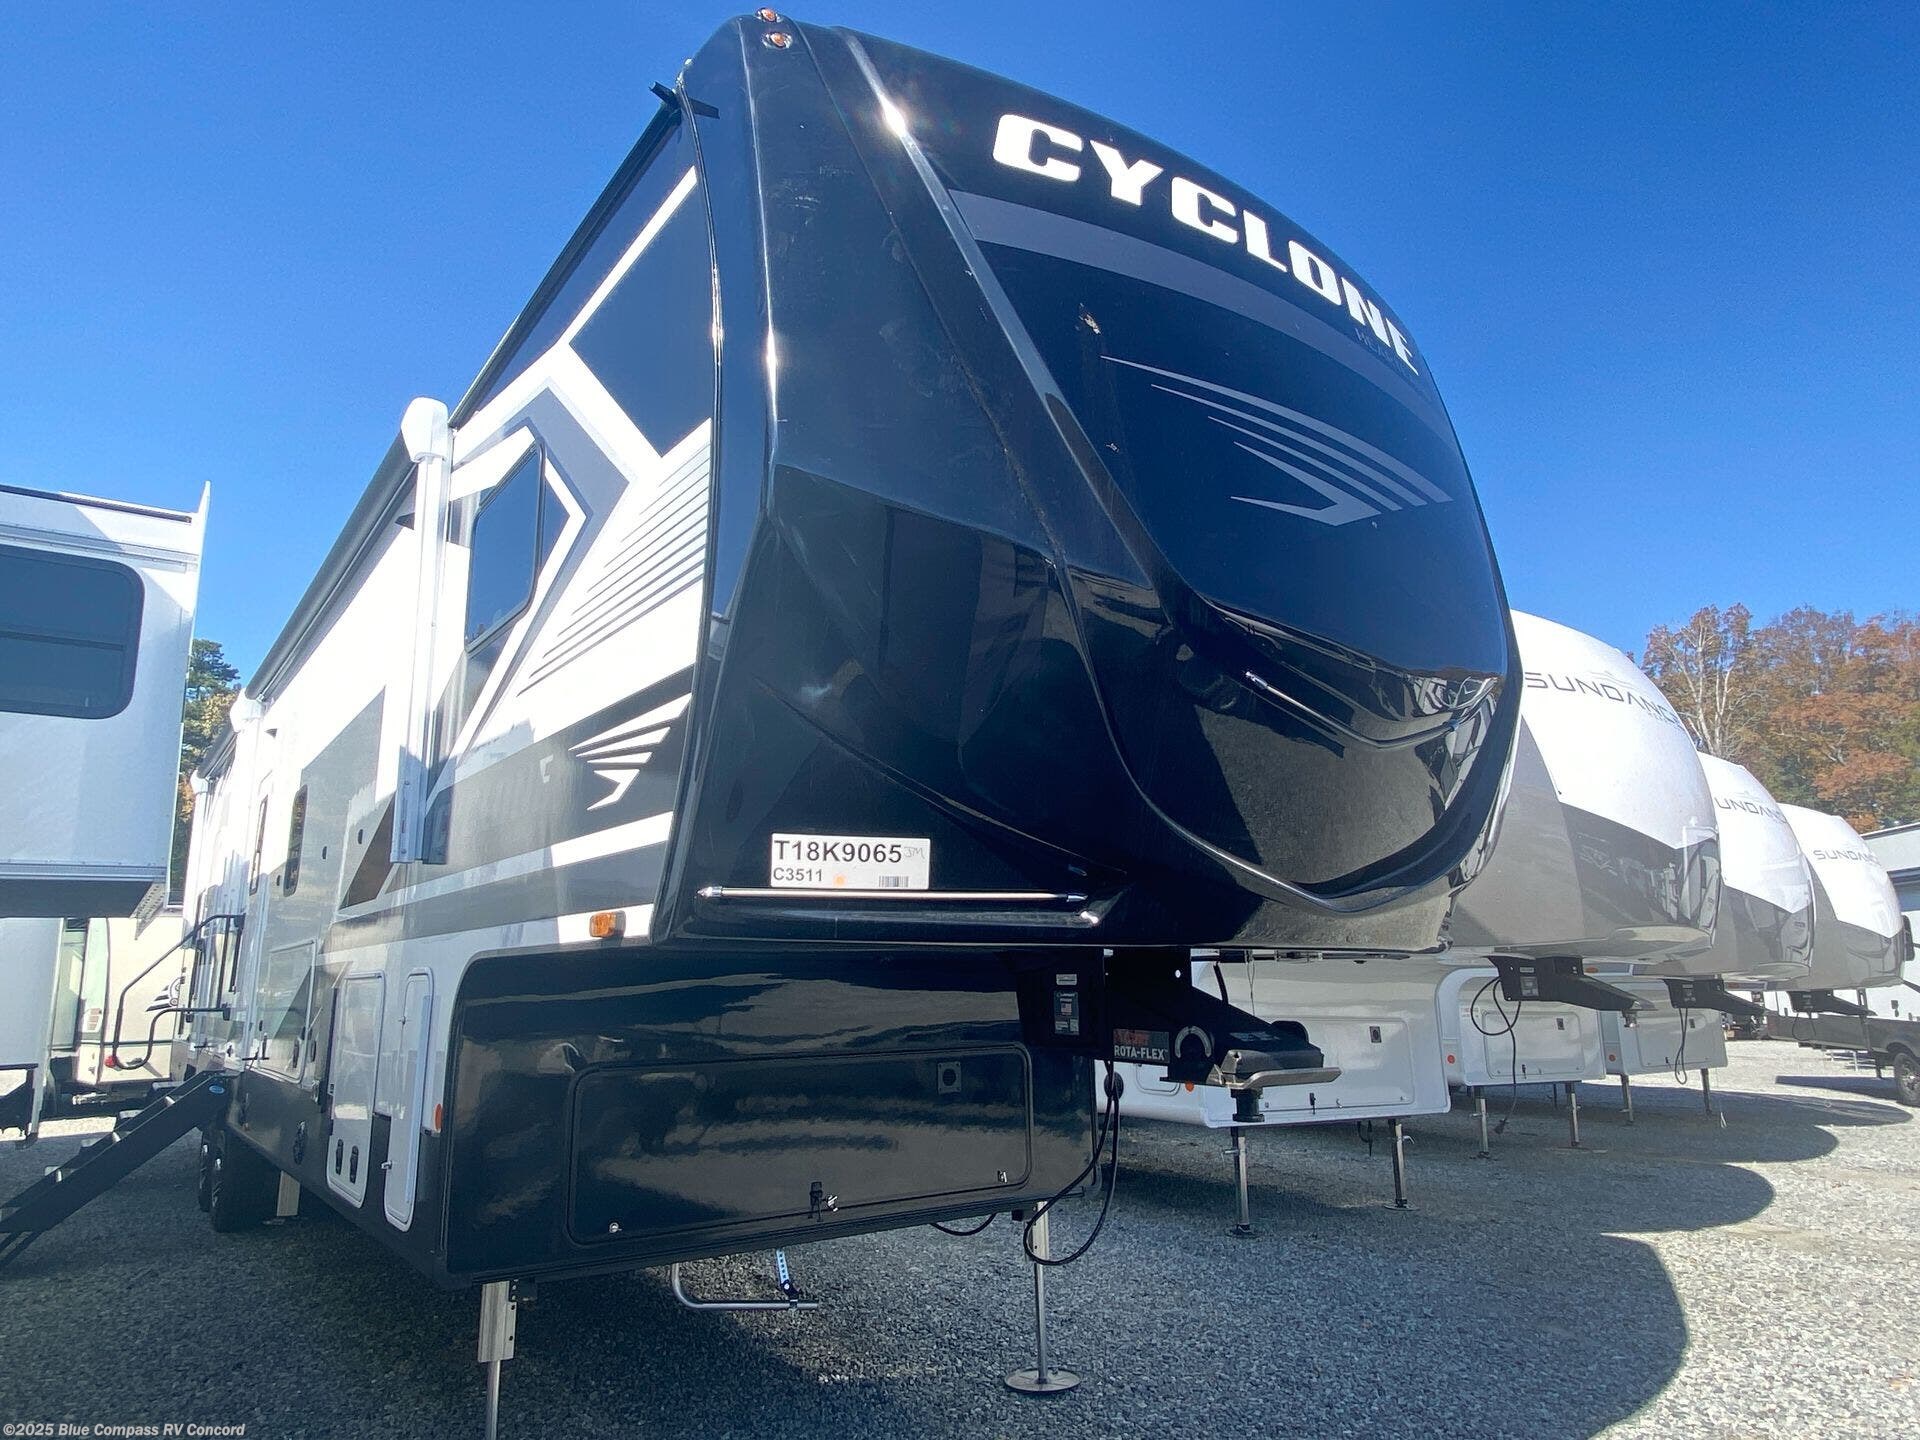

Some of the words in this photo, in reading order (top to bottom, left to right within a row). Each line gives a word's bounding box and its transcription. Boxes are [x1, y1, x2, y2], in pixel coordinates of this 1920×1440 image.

[992, 113, 1419, 377] CYCLONE
[774, 840, 902, 863] T18K9065
[773, 867, 823, 882] C3511
